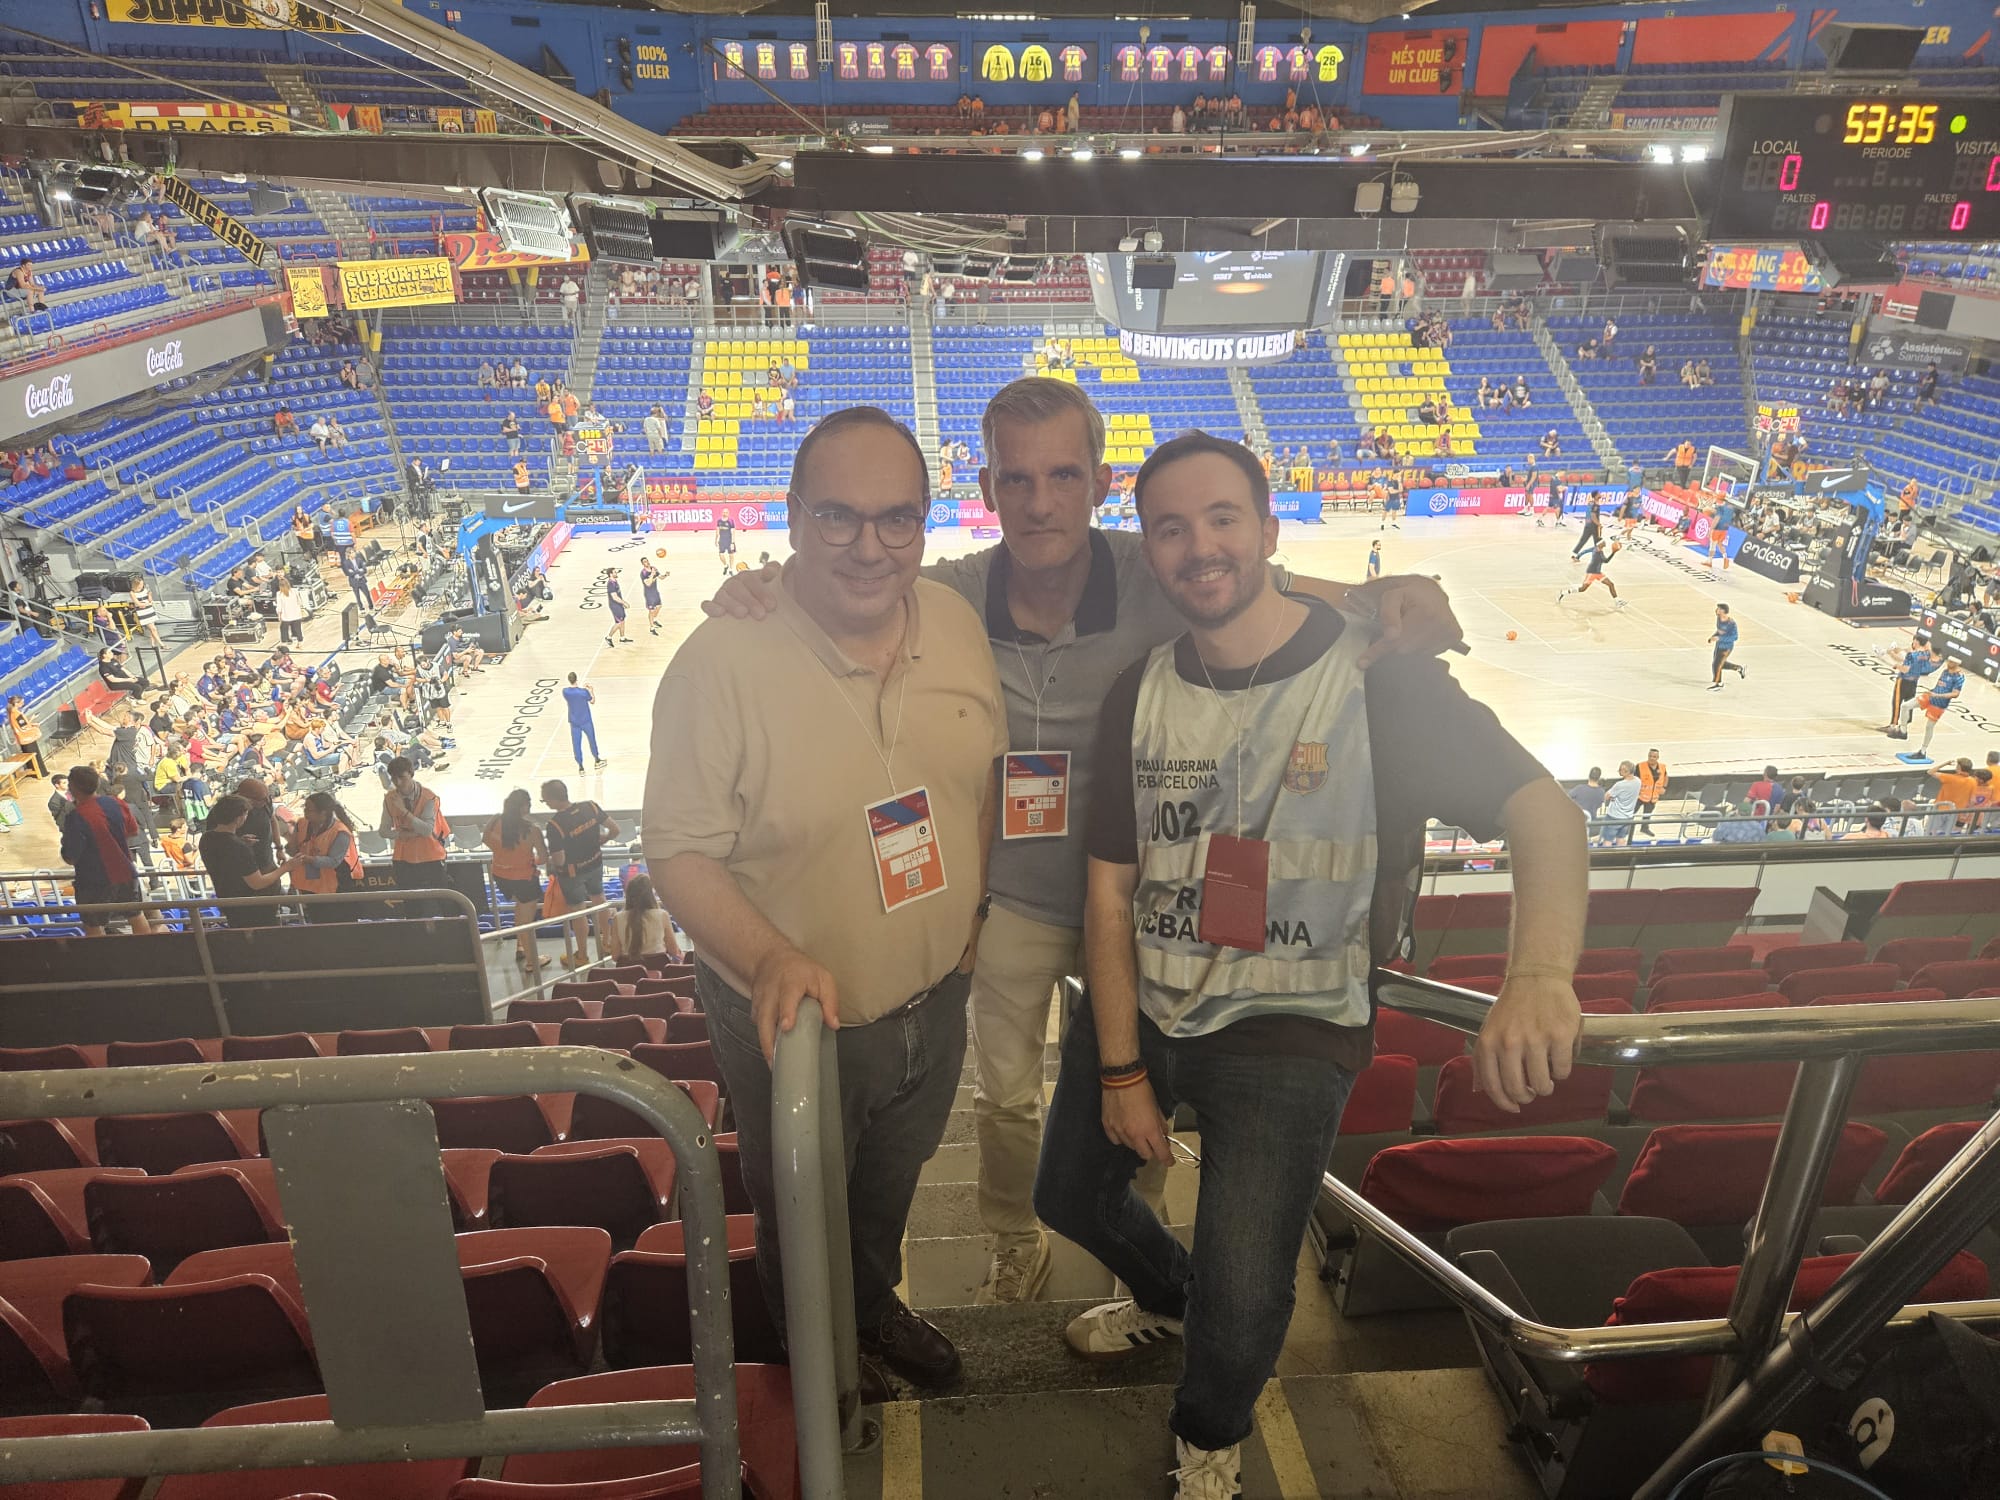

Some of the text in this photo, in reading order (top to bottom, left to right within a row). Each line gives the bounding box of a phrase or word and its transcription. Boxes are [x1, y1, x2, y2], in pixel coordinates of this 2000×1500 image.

[636, 45, 668, 62] 100%
[898, 53, 913, 65] 21
[1029, 55, 1042, 66] 16
[1322, 55, 1336, 66] 28
[1391, 44, 1443, 68] MÉS QUE
[636, 63, 670, 80] CULER
[1388, 68, 1439, 83] UN CLUB
[1842, 104, 1938, 144] 53:35
[1752, 140, 1801, 155] LOCAL
[1862, 147, 1913, 159] PERIODE
[1779, 154, 1802, 191] 0
[1782, 193, 1817, 204] FALTES
[1924, 193, 1958, 204] FALTES
[164, 177, 262, 260] DRACS 1991
[1810, 202, 1829, 230] 0
[1951, 202, 1971, 230] 0
[1738, 254, 1778, 273] SANG
[344, 262, 449, 288] SUPPORTERS
[1133, 332, 1236, 360] BENVINGUTS
[1236, 333, 1287, 360] CULERS
[588, 440, 606, 453] 24
[1742, 540, 1793, 570] endesa
[475, 678, 560, 780] #ligaendesa
[1160, 759, 1218, 773] LAUGRANA
